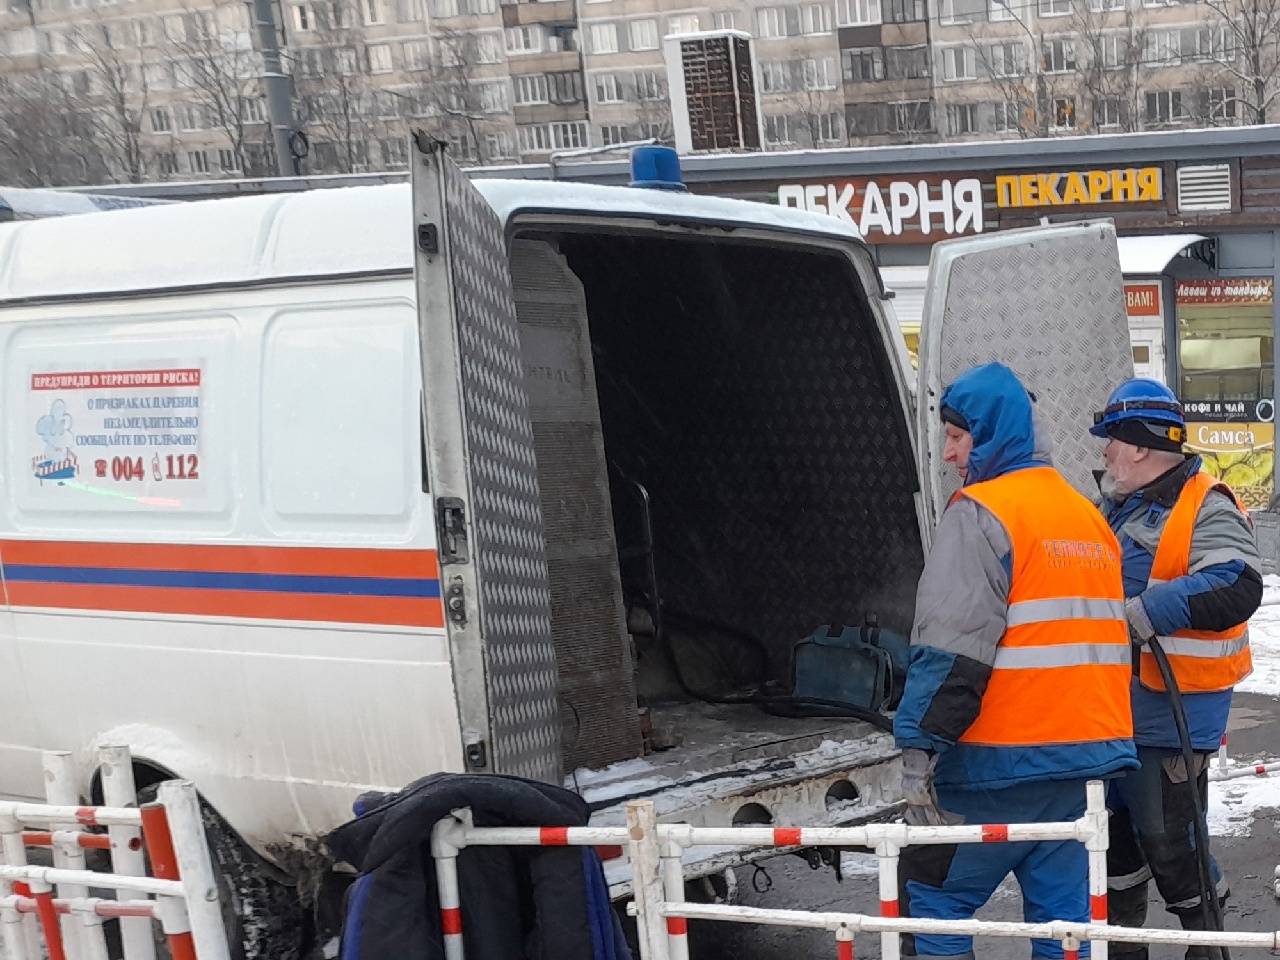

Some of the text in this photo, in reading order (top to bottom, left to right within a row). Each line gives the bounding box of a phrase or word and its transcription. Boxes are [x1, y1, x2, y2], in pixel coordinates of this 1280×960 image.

[996, 167, 1162, 208] ПЕКАРНЯ
[1177, 284, 1208, 297] Лаваш
[1210, 284, 1221, 297] из
[1127, 290, 1154, 307] ВАМ!
[92, 374, 99, 386] О
[101, 372, 161, 386] ТЕРРИТОРИИ
[162, 371, 199, 384] РИСКА!
[87, 396, 199, 410] О ПРИЗНАКАХ ПАРЕНИЯ
[1184, 401, 1245, 413] КОФЕ И ЧАЙ
[133, 434, 147, 446] ПО
[1198, 425, 1254, 445] Самса
[112, 453, 199, 481] 004 112
